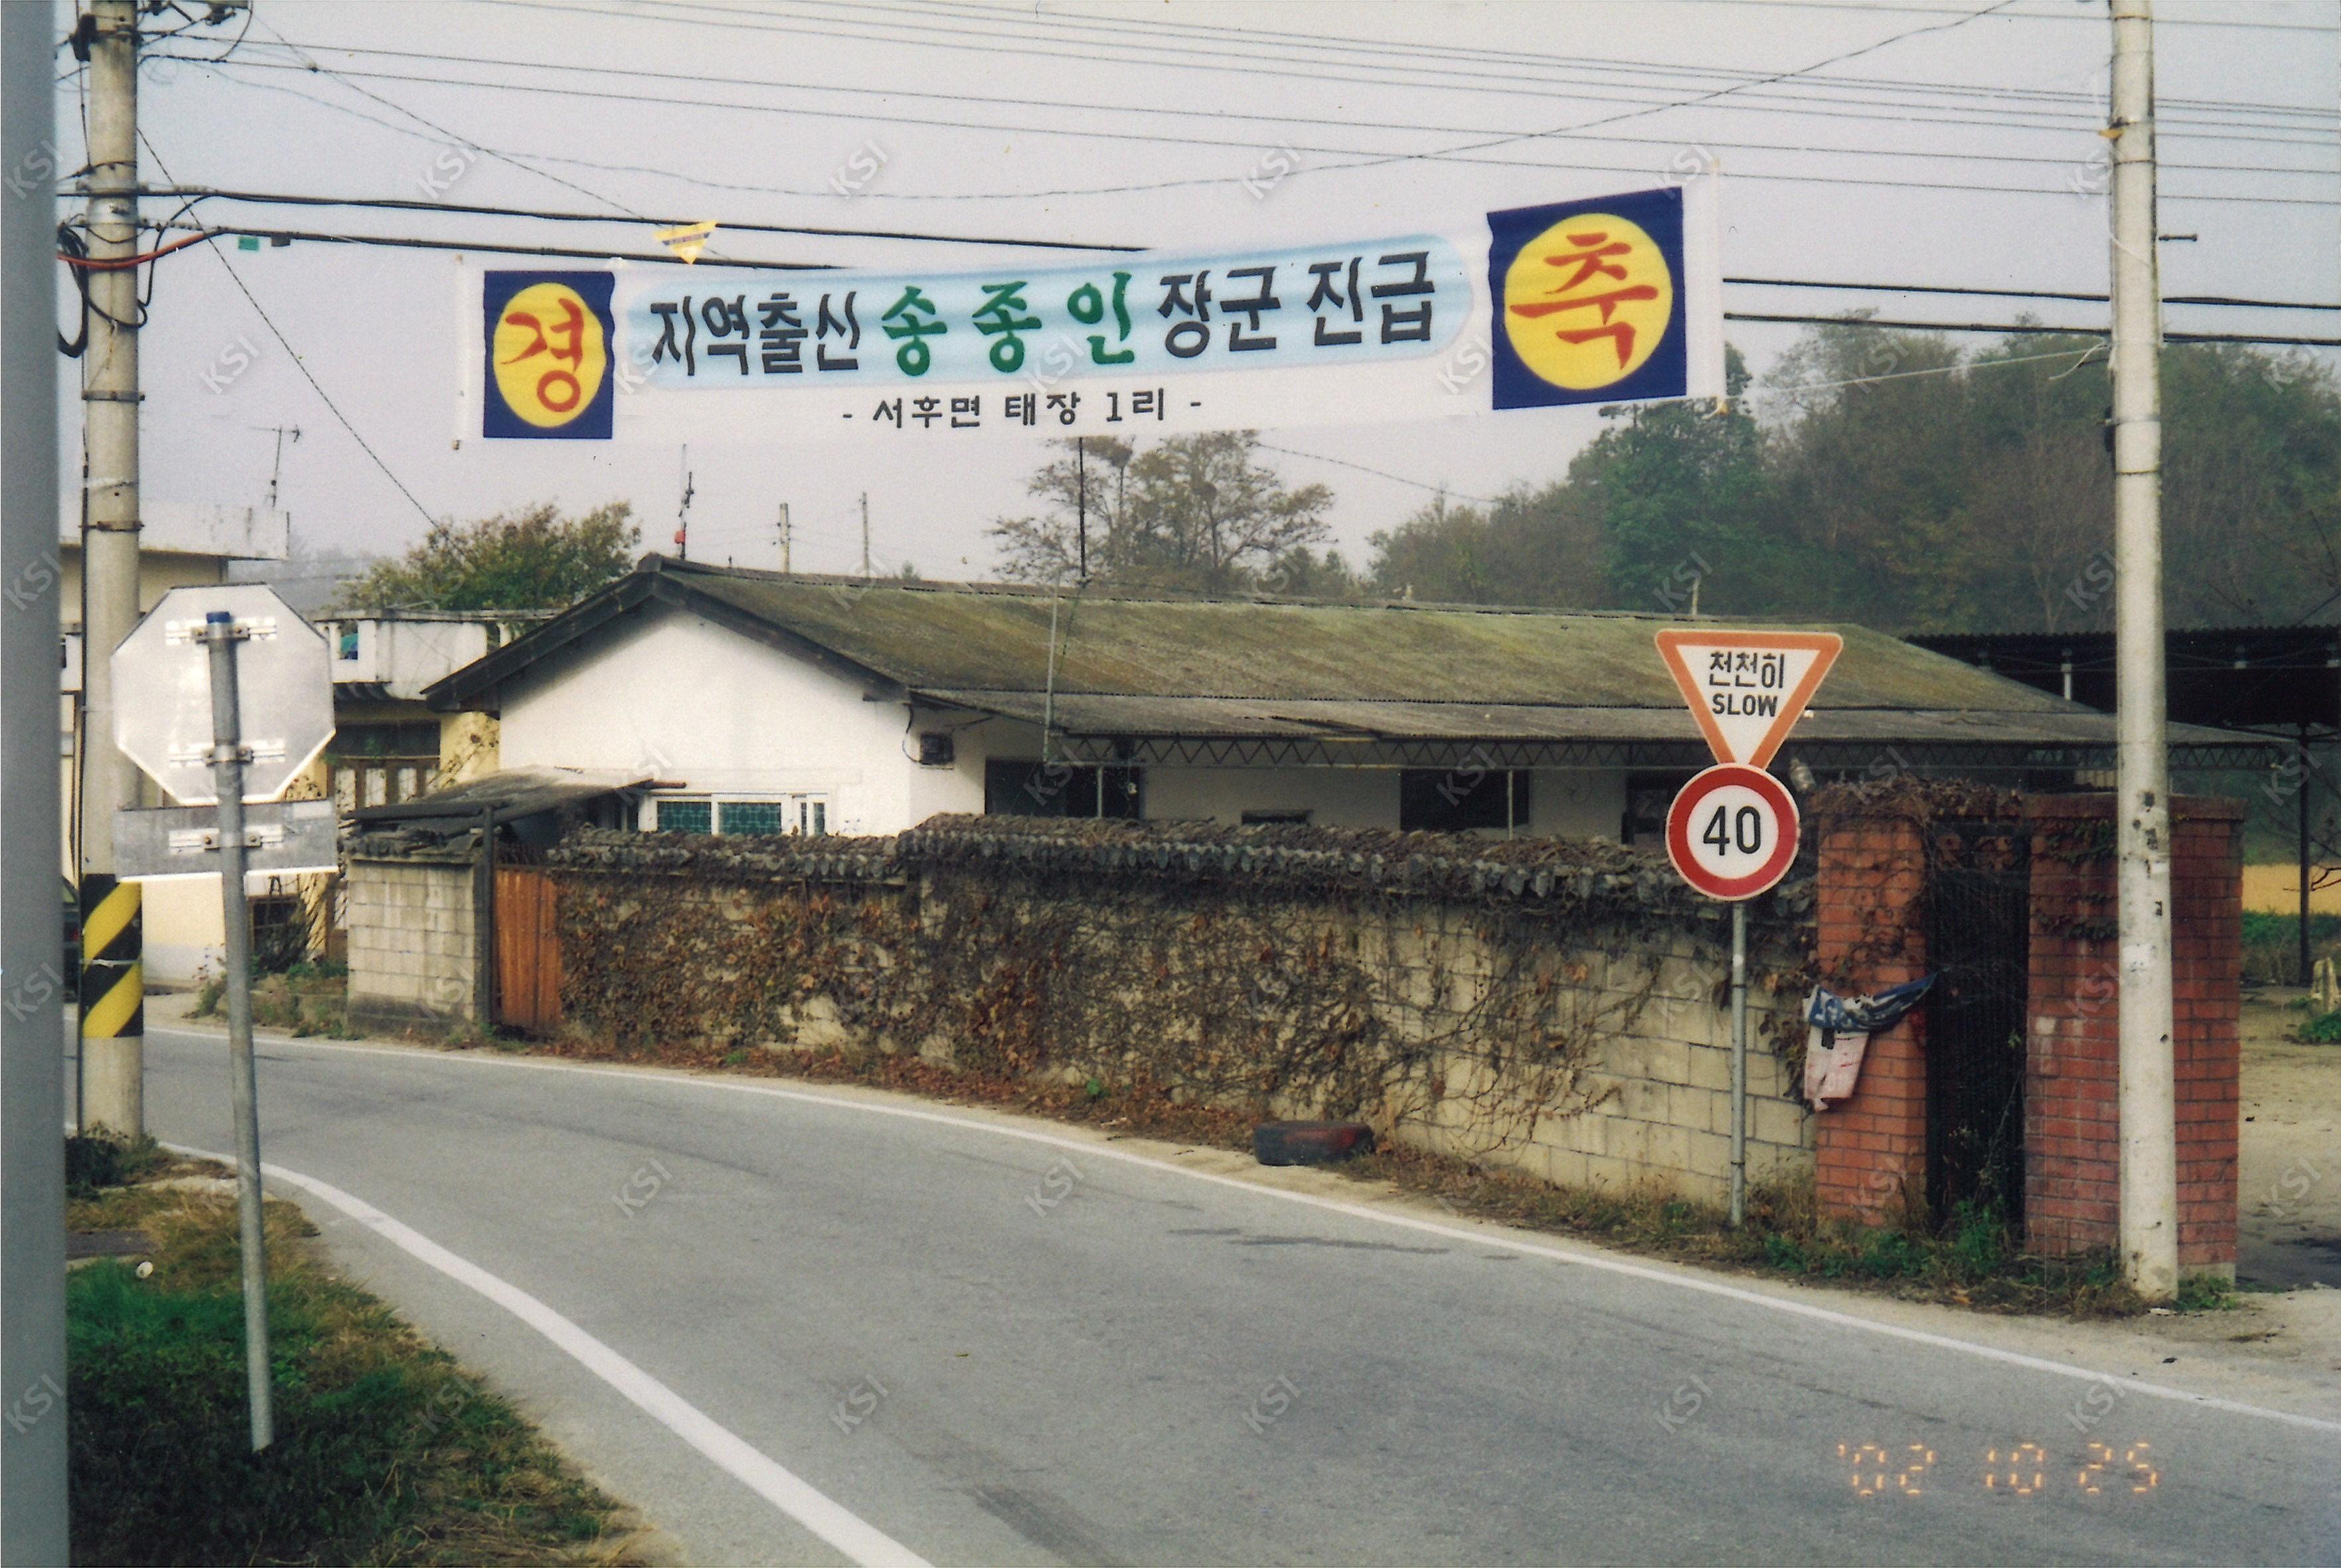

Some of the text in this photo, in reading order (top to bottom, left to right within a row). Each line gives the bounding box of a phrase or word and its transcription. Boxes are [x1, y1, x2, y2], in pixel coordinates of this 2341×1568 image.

[649, 291, 861, 376] 지역출신
[1157, 266, 1281, 358] 장군
[1306, 251, 1435, 347] 진급
[1510, 232, 1659, 370] 축
[499, 297, 584, 412] 경
[872, 394, 981, 429] 서후면
[1005, 392, 1082, 426] 태장
[1106, 388, 1165, 422] 1리
[1708, 650, 1785, 689] 천천히
[1712, 693, 1779, 718] SLOW
[1702, 805, 1762, 856] 40
